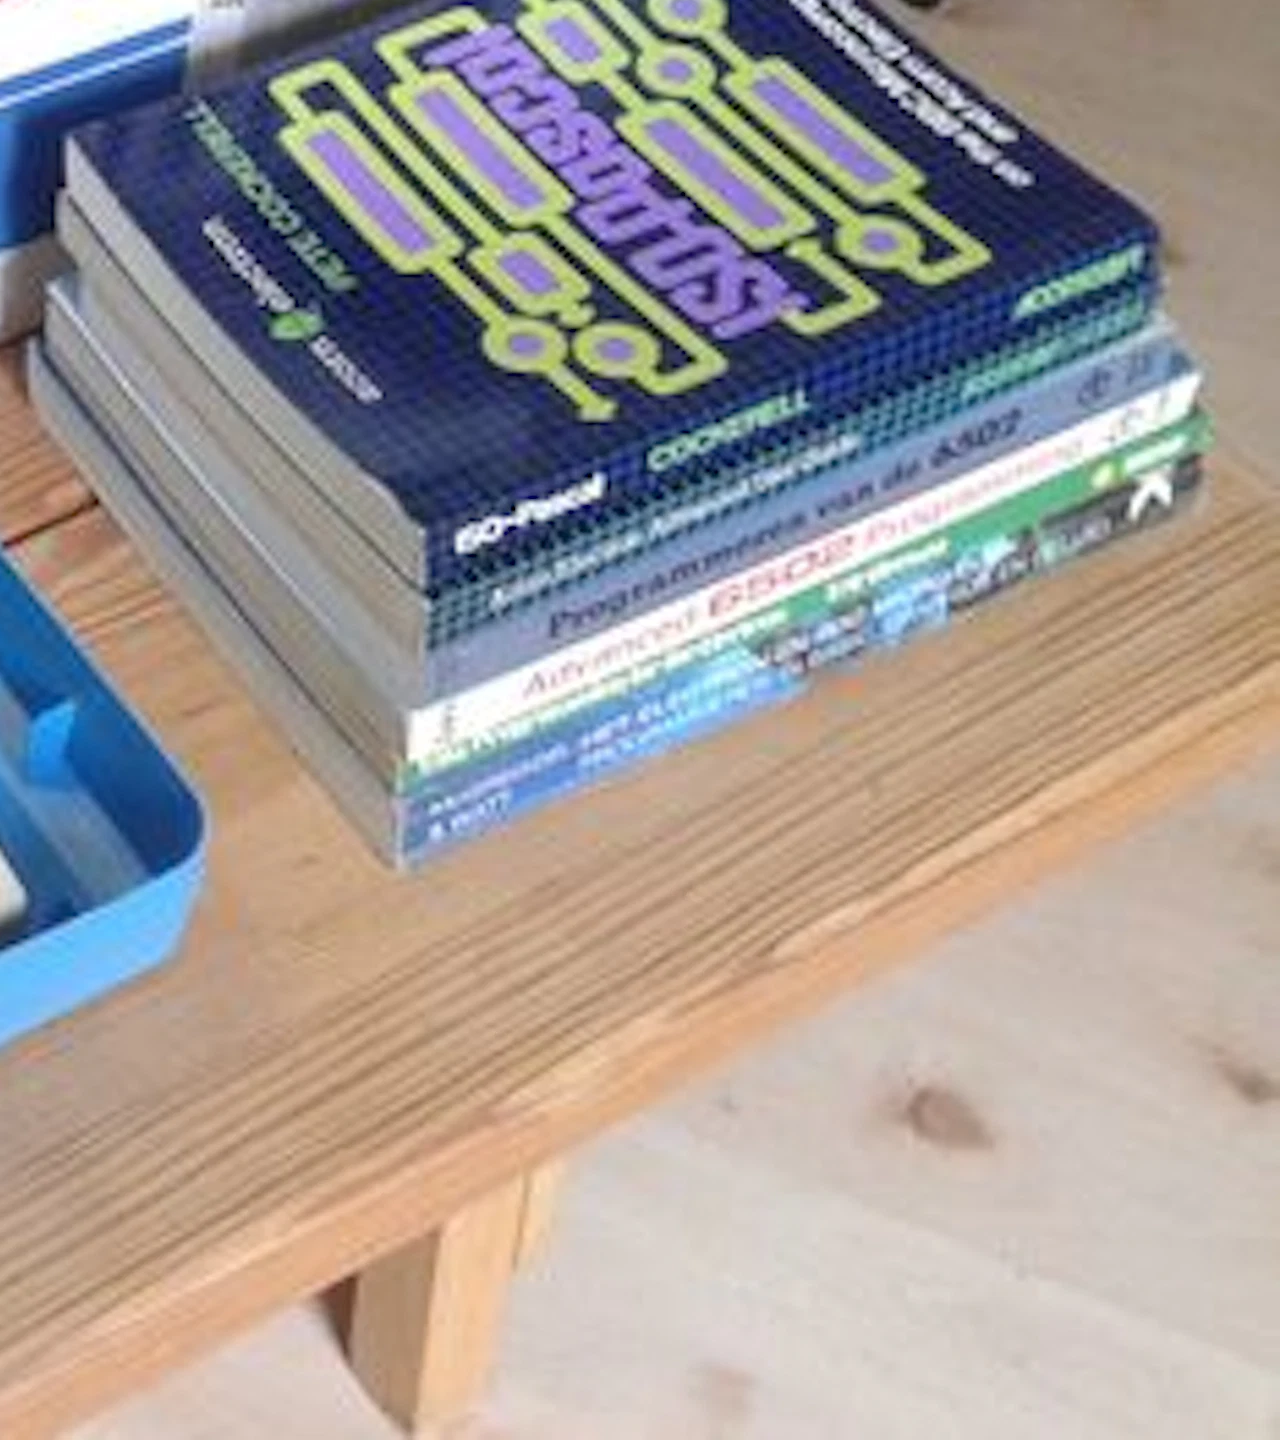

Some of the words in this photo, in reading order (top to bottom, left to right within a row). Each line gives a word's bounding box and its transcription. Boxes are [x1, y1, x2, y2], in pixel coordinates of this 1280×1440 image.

[514, 598, 709, 699] Advanced
[699, 530, 865, 621] 6502
[859, 437, 1092, 552] Programming
[540, 506, 818, 641] Programmeren
[812, 481, 872, 522] van
[868, 454, 925, 495] de
[924, 405, 1030, 470] 6502
